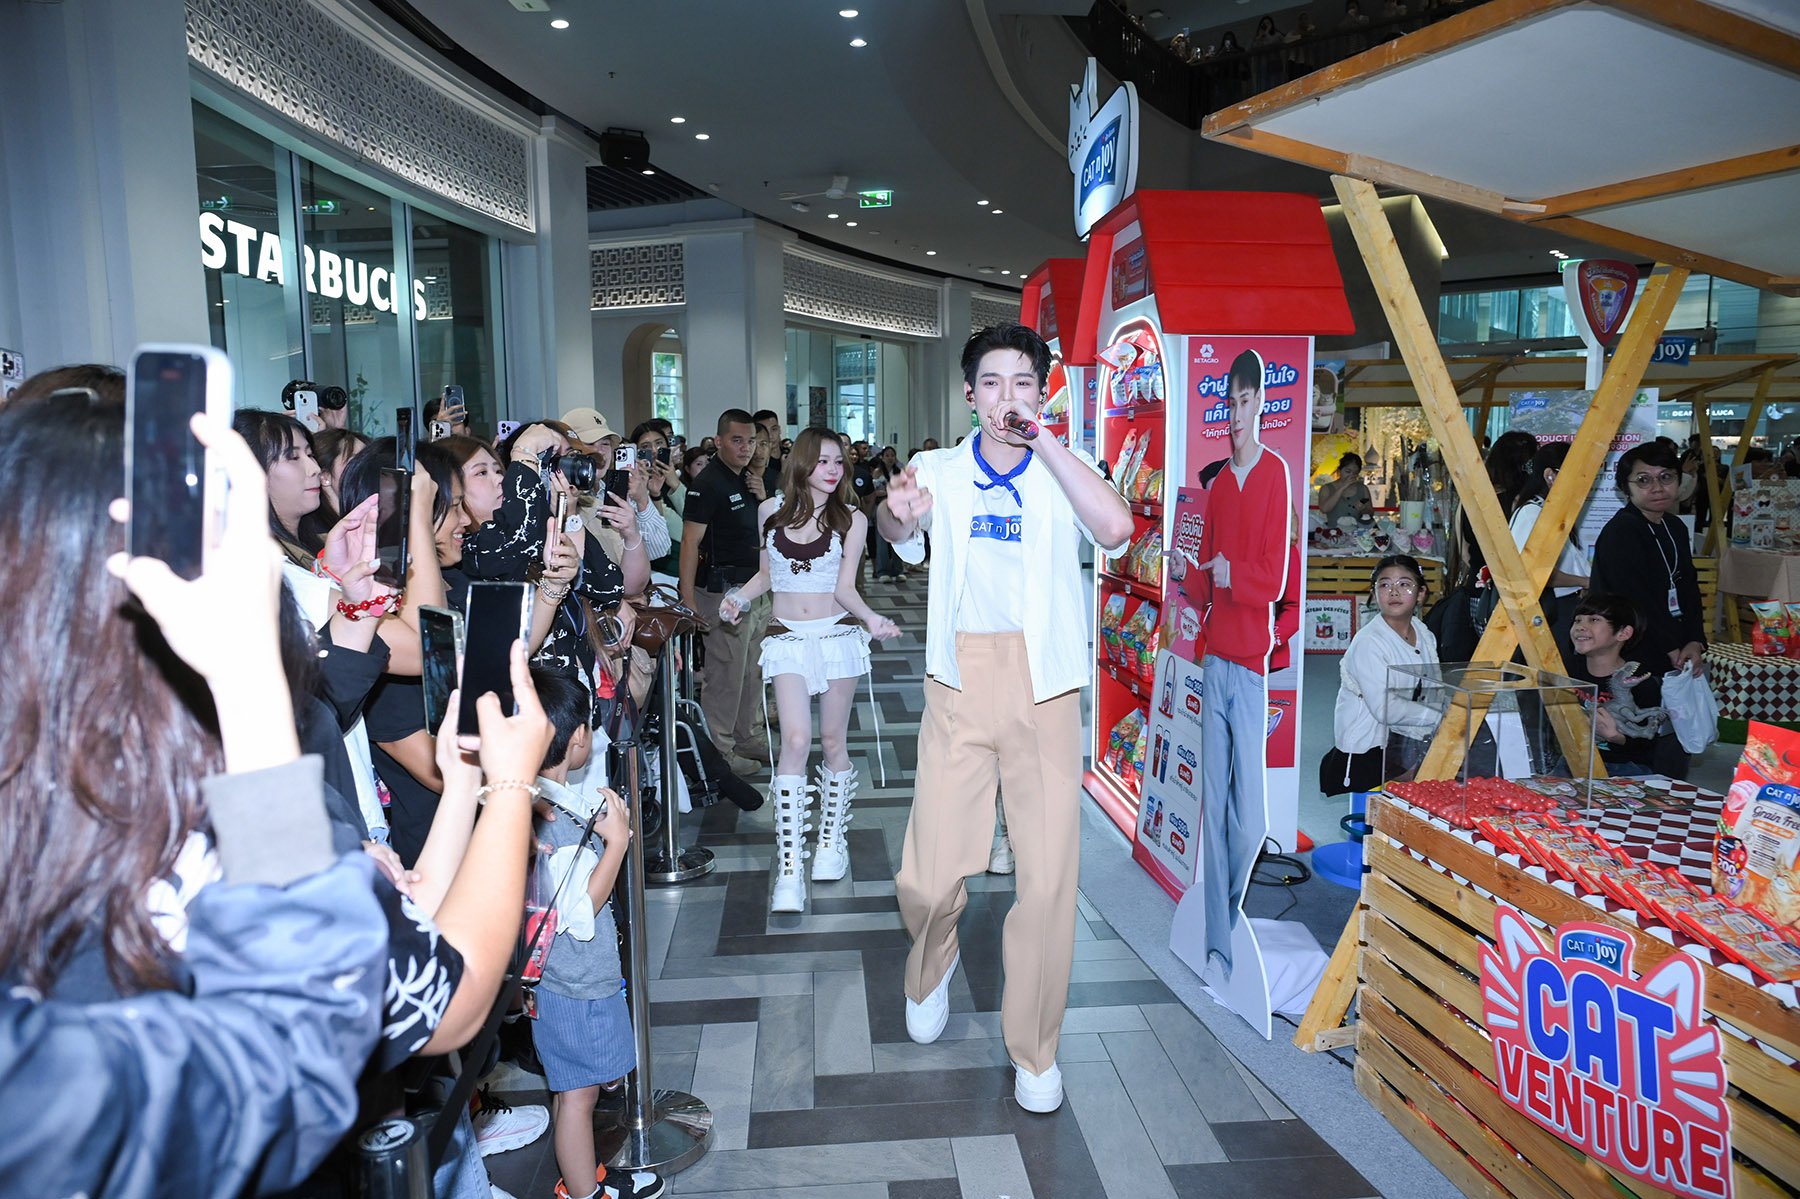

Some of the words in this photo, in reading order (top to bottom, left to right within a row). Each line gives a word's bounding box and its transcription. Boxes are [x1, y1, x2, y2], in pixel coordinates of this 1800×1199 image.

[1083, 160, 1095, 187] CAT
[971, 520, 993, 533] CAT
[1766, 787, 1784, 798] CAT
[1752, 806, 1781, 823] Grain
[1717, 857, 1736, 875] 200
[1567, 939, 1585, 952] CAT
[1588, 944, 1594, 953] n
[1594, 937, 1617, 964] joy
[1526, 957, 1676, 1103] CAT
[1498, 1038, 1727, 1196] VENTURE
